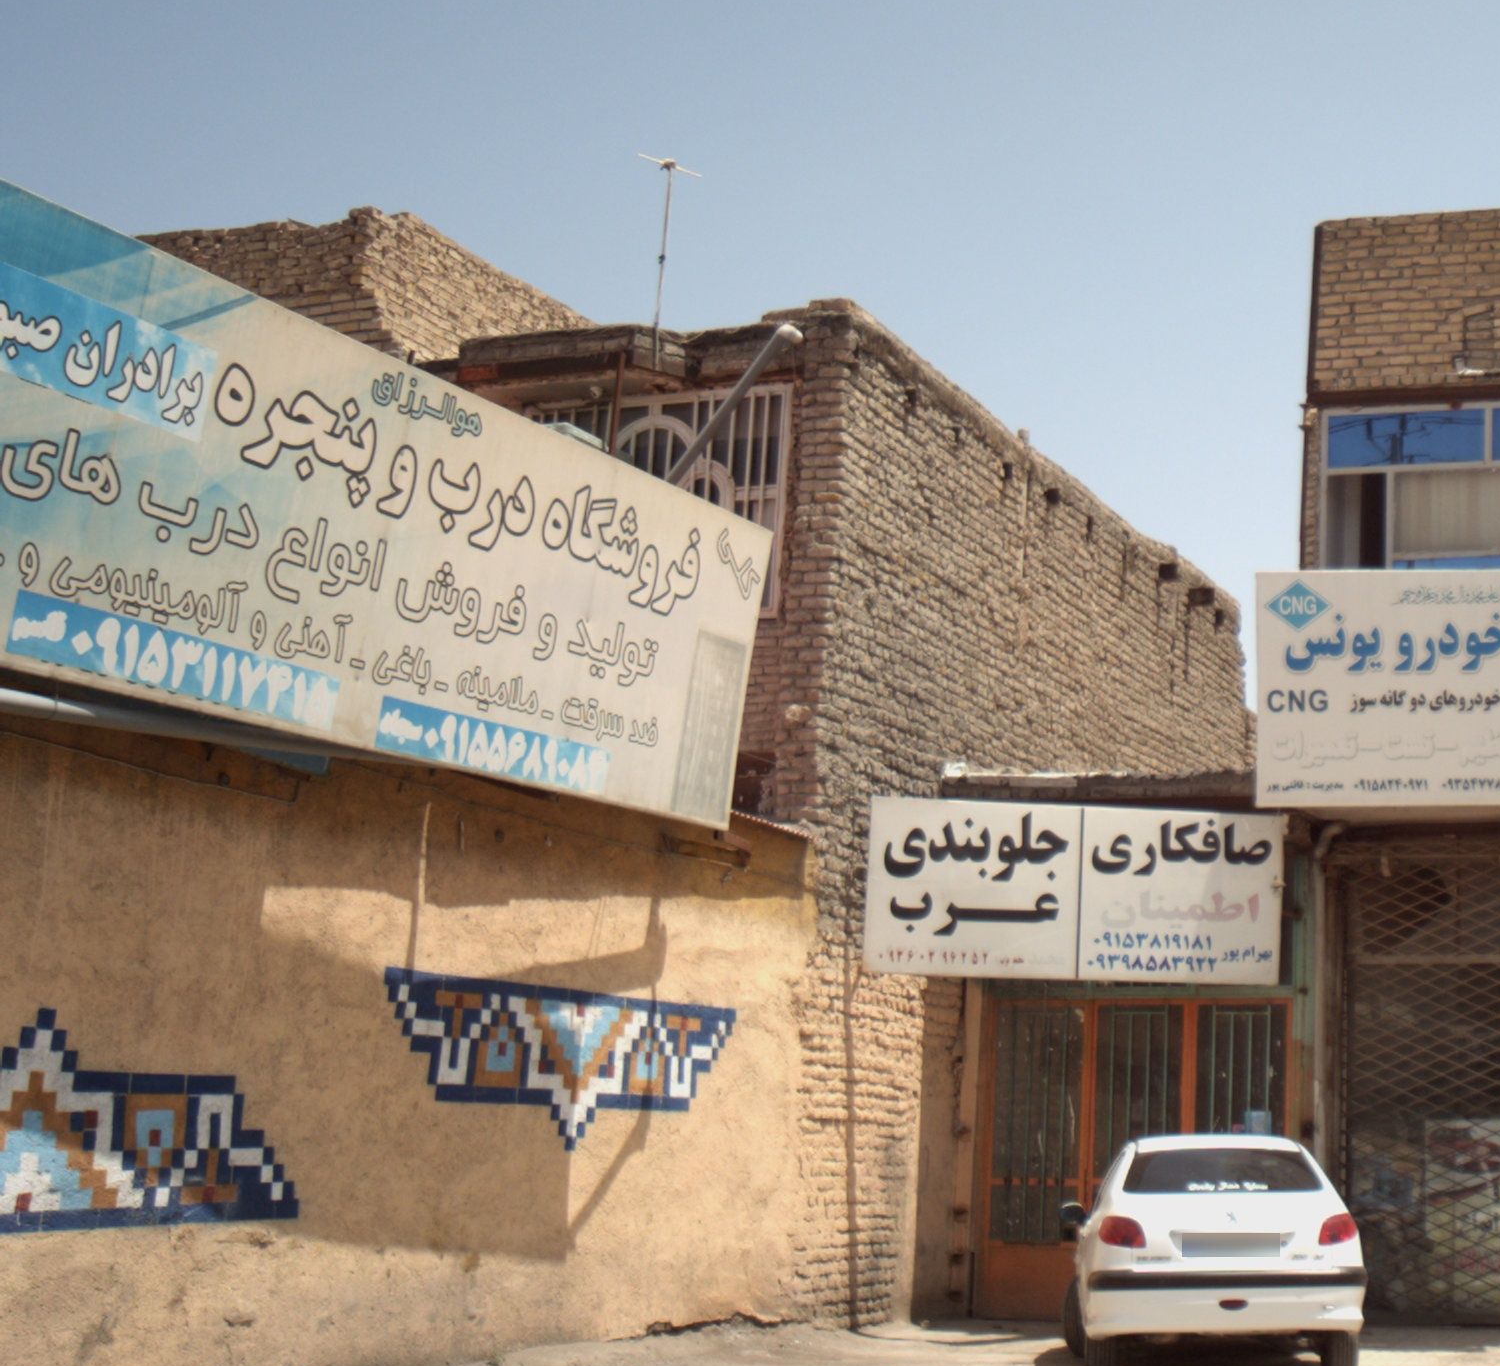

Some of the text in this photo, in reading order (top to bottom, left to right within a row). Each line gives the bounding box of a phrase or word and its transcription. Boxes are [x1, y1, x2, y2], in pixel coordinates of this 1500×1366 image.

[64, 320, 203, 426] برادران
[214, 362, 377, 508] پنجره
[376, 444, 418, 519] و
[428, 458, 535, 551] درب
[1, 428, 659, 686] تولید و فروش انواع درب های
[19, 542, 40, 587] و
[542, 485, 701, 616] فروشگاه
[50, 556, 248, 636] آلومینیومی
[1278, 596, 1317, 616] CNG
[250, 610, 267, 650] و
[274, 614, 353, 665] آهنی
[1285, 614, 1383, 672] یونس
[372, 645, 431, 696] باغی
[457, 667, 538, 714] ملامینه
[560, 698, 624, 741] سرقت
[1267, 689, 1329, 713] CNG
[1350, 695, 1377, 713] سوز
[628, 716, 659, 747] ضد
[884, 810, 1069, 882] جلوبندی
[1091, 818, 1273, 876] صافکاری
[889, 891, 1060, 936] عرب
[1101, 890, 1260, 929] اطمینان
[1094, 931, 1213, 951] ۰۹۱۵۳۸۱۹۱۸۱
